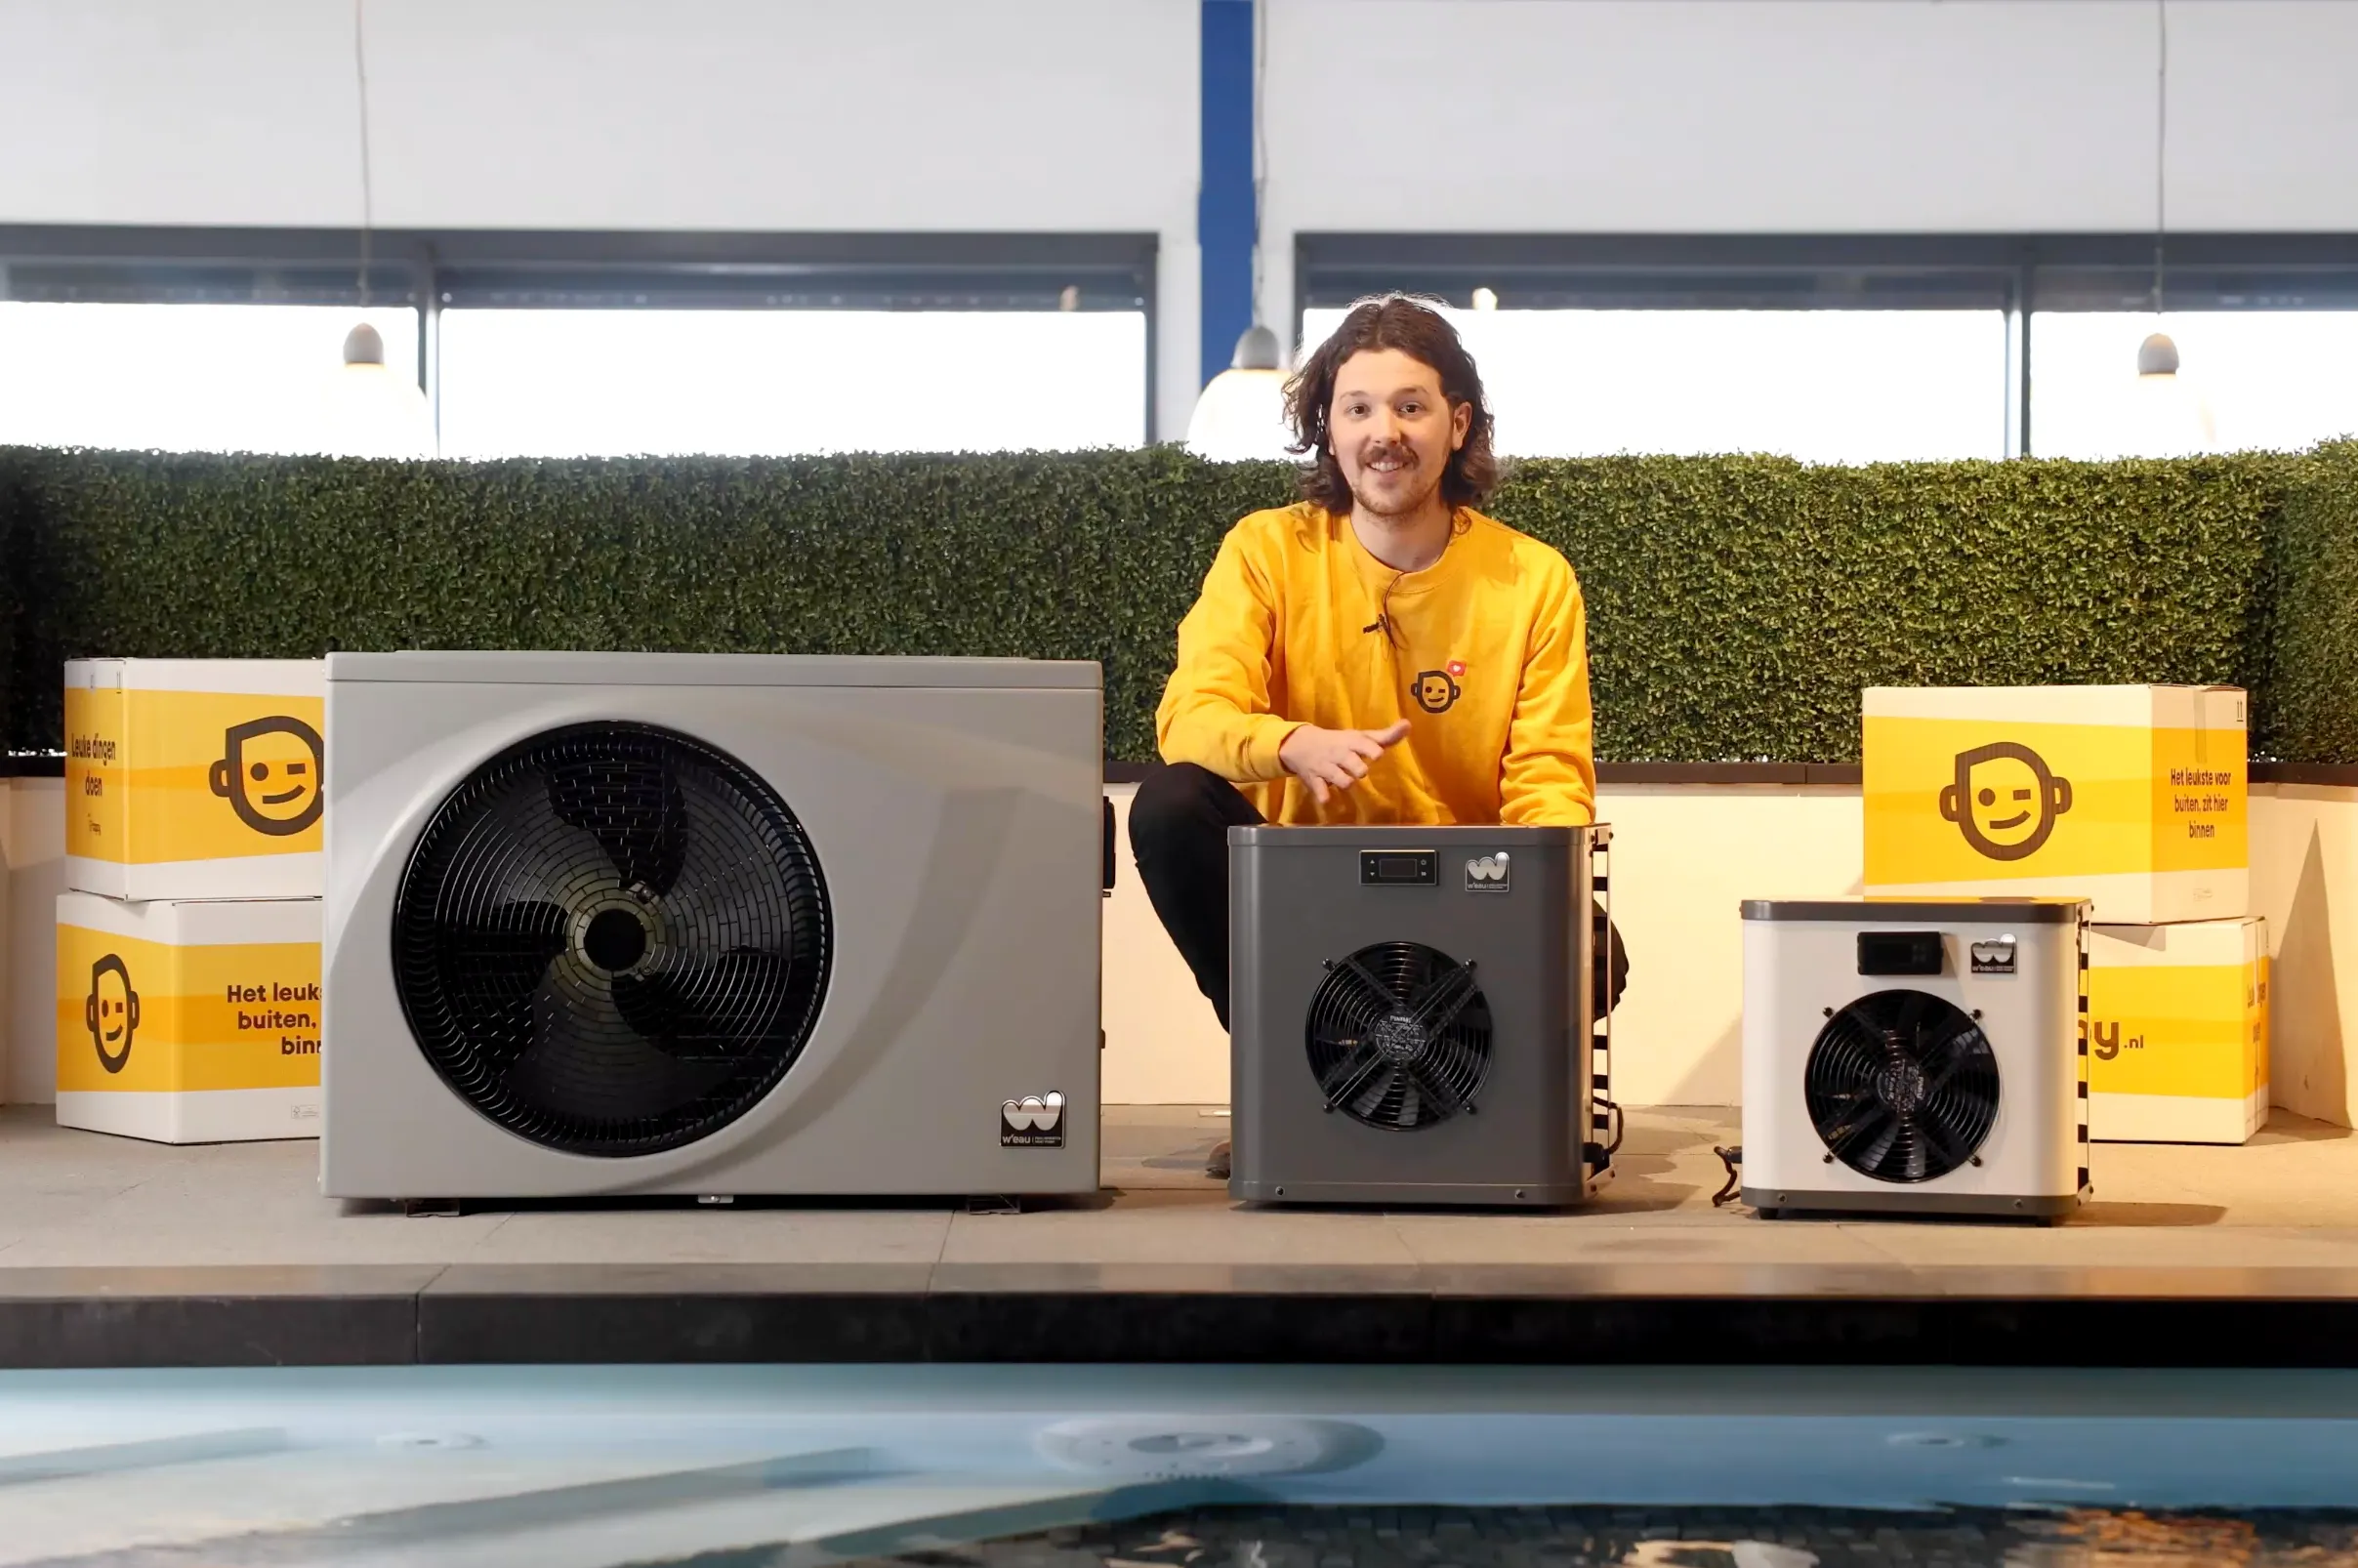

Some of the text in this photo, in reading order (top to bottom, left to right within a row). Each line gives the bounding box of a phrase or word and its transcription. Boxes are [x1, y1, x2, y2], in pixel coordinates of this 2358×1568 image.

[71, 732, 116, 765] Leuke dingen
[85, 769, 103, 796] doen
[2171, 766, 2232, 786] Het leukste voor
[2174, 794, 2228, 814] buiten, zit hier
[2188, 820, 2215, 839] binnen
[228, 982, 321, 1003] Het leuk
[237, 1010, 317, 1030] buiten,
